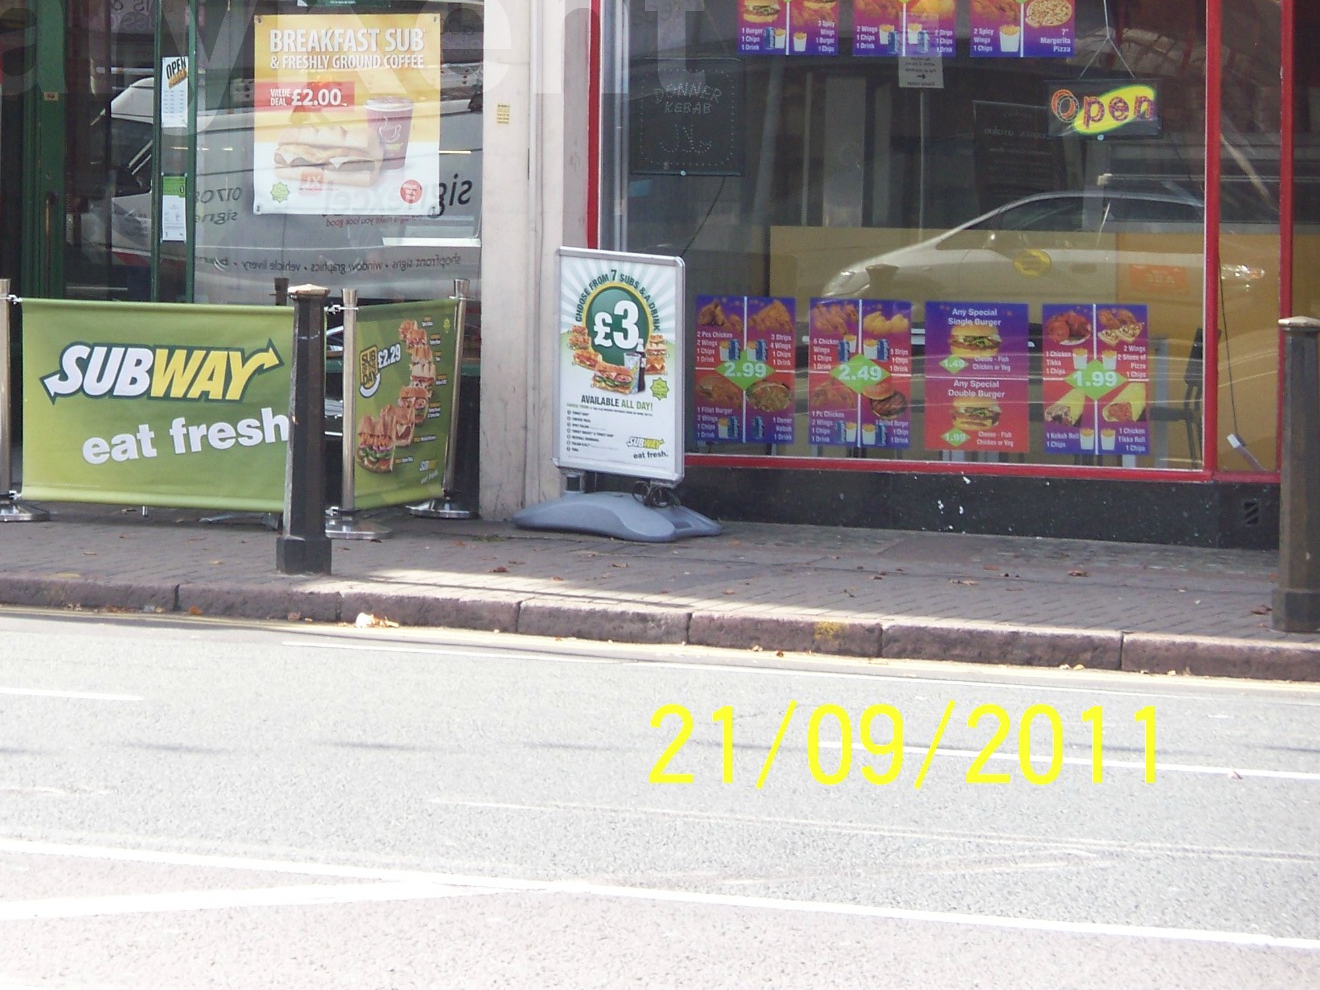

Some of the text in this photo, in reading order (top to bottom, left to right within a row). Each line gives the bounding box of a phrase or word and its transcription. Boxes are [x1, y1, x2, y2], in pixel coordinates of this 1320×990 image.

[979, 28, 995, 36] Spicy
[269, 28, 424, 53] BREAKFAST SUB
[974, 36, 991, 44] Wings
[1053, 45, 1071, 53] Pizza
[166, 57, 188, 80] OPEN
[270, 55, 424, 70] & FRESHLY GROUND COFFEE
[270, 88, 290, 97] VALUE
[291, 88, 342, 106] £2.00
[270, 98, 287, 106] DEAL
[665, 101, 711, 115] KEBAB
[1051, 89, 1156, 129] Open
[575, 269, 661, 331] CHOOSE FROM 7 SUBS & A DRINK
[952, 308, 997, 317] Any Special
[594, 300, 640, 349] £3
[948, 318, 1002, 327] Single Burger
[378, 343, 401, 369] £2.29
[43, 343, 282, 401] SUBWAY
[724, 362, 767, 378] 2.99
[838, 364, 882, 381] 2.49
[953, 380, 999, 388] Any Special
[1073, 371, 1117, 387] 1.99
[948, 389, 1005, 399] Double Burger
[581, 394, 619, 408] AVAILABLE
[621, 399, 634, 409] ALL
[636, 400, 653, 411] DAY!
[82, 407, 289, 464] eat fresh
[626, 436, 665, 450] SUBWAY
[633, 451, 646, 459] eat
